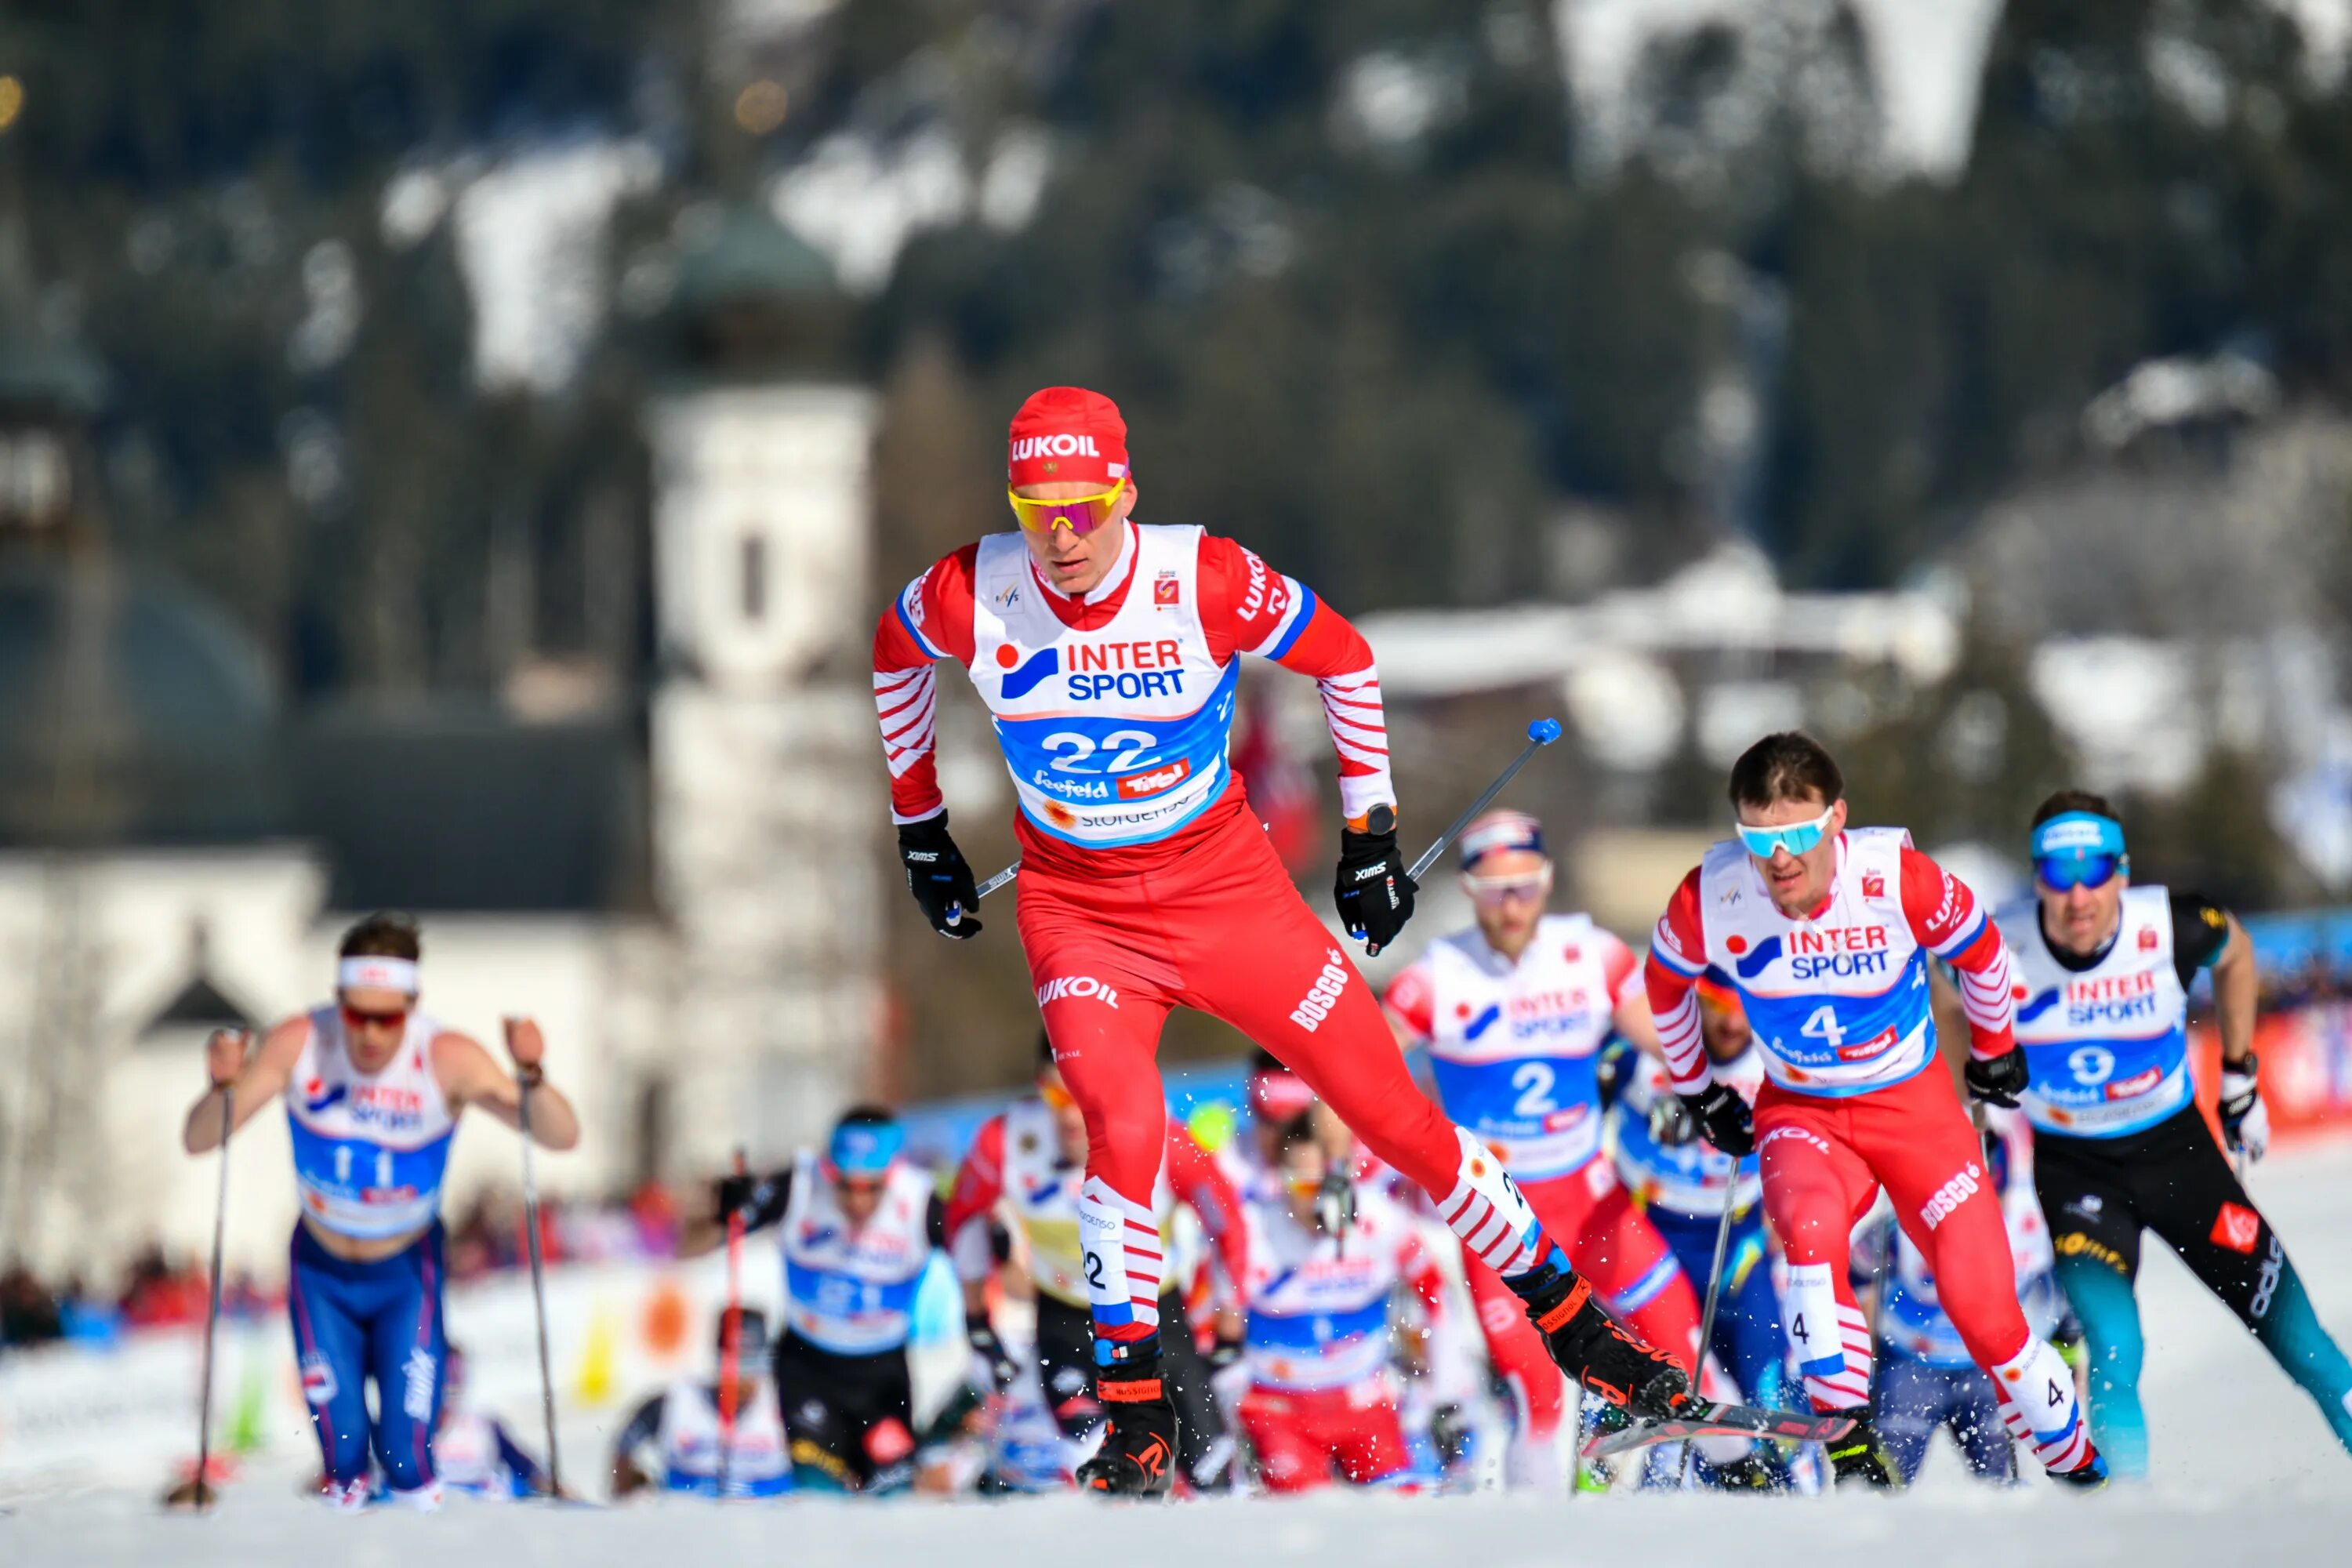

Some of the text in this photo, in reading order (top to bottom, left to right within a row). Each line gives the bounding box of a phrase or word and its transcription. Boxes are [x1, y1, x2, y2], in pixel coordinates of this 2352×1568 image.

[1012, 434, 1100, 461] LUKOIL
[1068, 640, 1181, 671] INTER
[1068, 669, 1185, 701] SPORT
[1041, 730, 1162, 774] 22
[1033, 764, 1184, 798] Seefeld Tirol
[1789, 926, 1887, 955] INTER
[1791, 950, 1889, 979] SPORT
[1037, 976, 1120, 1010] LUKOIL
[1290, 963, 1349, 1033] BOSCO
[2067, 970, 2154, 1003] INTER
[2067, 993, 2156, 1025] SPORT
[1800, 1005, 1847, 1047] 4
[2068, 1046, 2116, 1086] 9
[1512, 1062, 1559, 1116] 2
[1919, 1171, 1979, 1231] BOSCO
[1793, 1312, 1810, 1345] 4
[2048, 1377, 2065, 1408] 4
